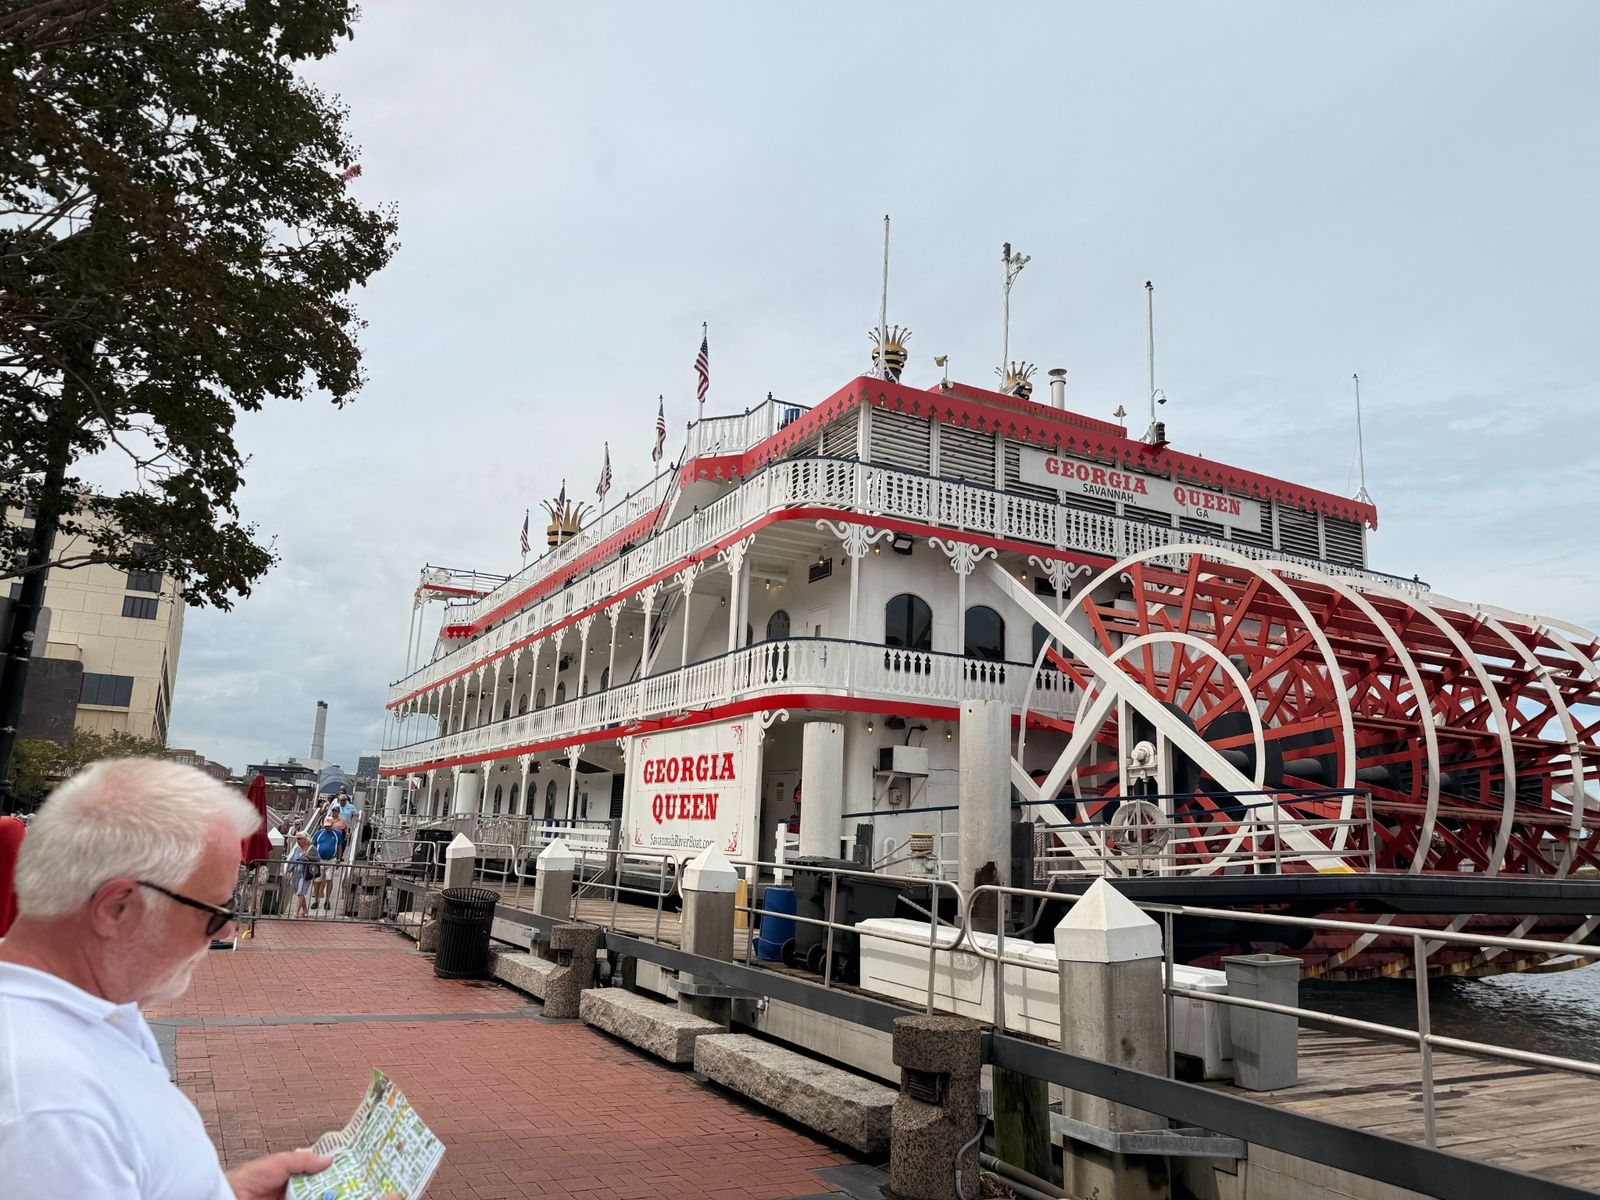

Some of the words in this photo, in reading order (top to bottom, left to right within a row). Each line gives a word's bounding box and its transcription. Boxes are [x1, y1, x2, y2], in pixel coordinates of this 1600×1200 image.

[1044, 457, 1148, 495] GEORGIA
[1173, 486, 1241, 516] QUEEN
[1083, 483, 1136, 505] SAVANNAH,
[1196, 508, 1209, 519] GA
[643, 753, 735, 784] GEORGIA
[652, 793, 719, 825] QUEEN
